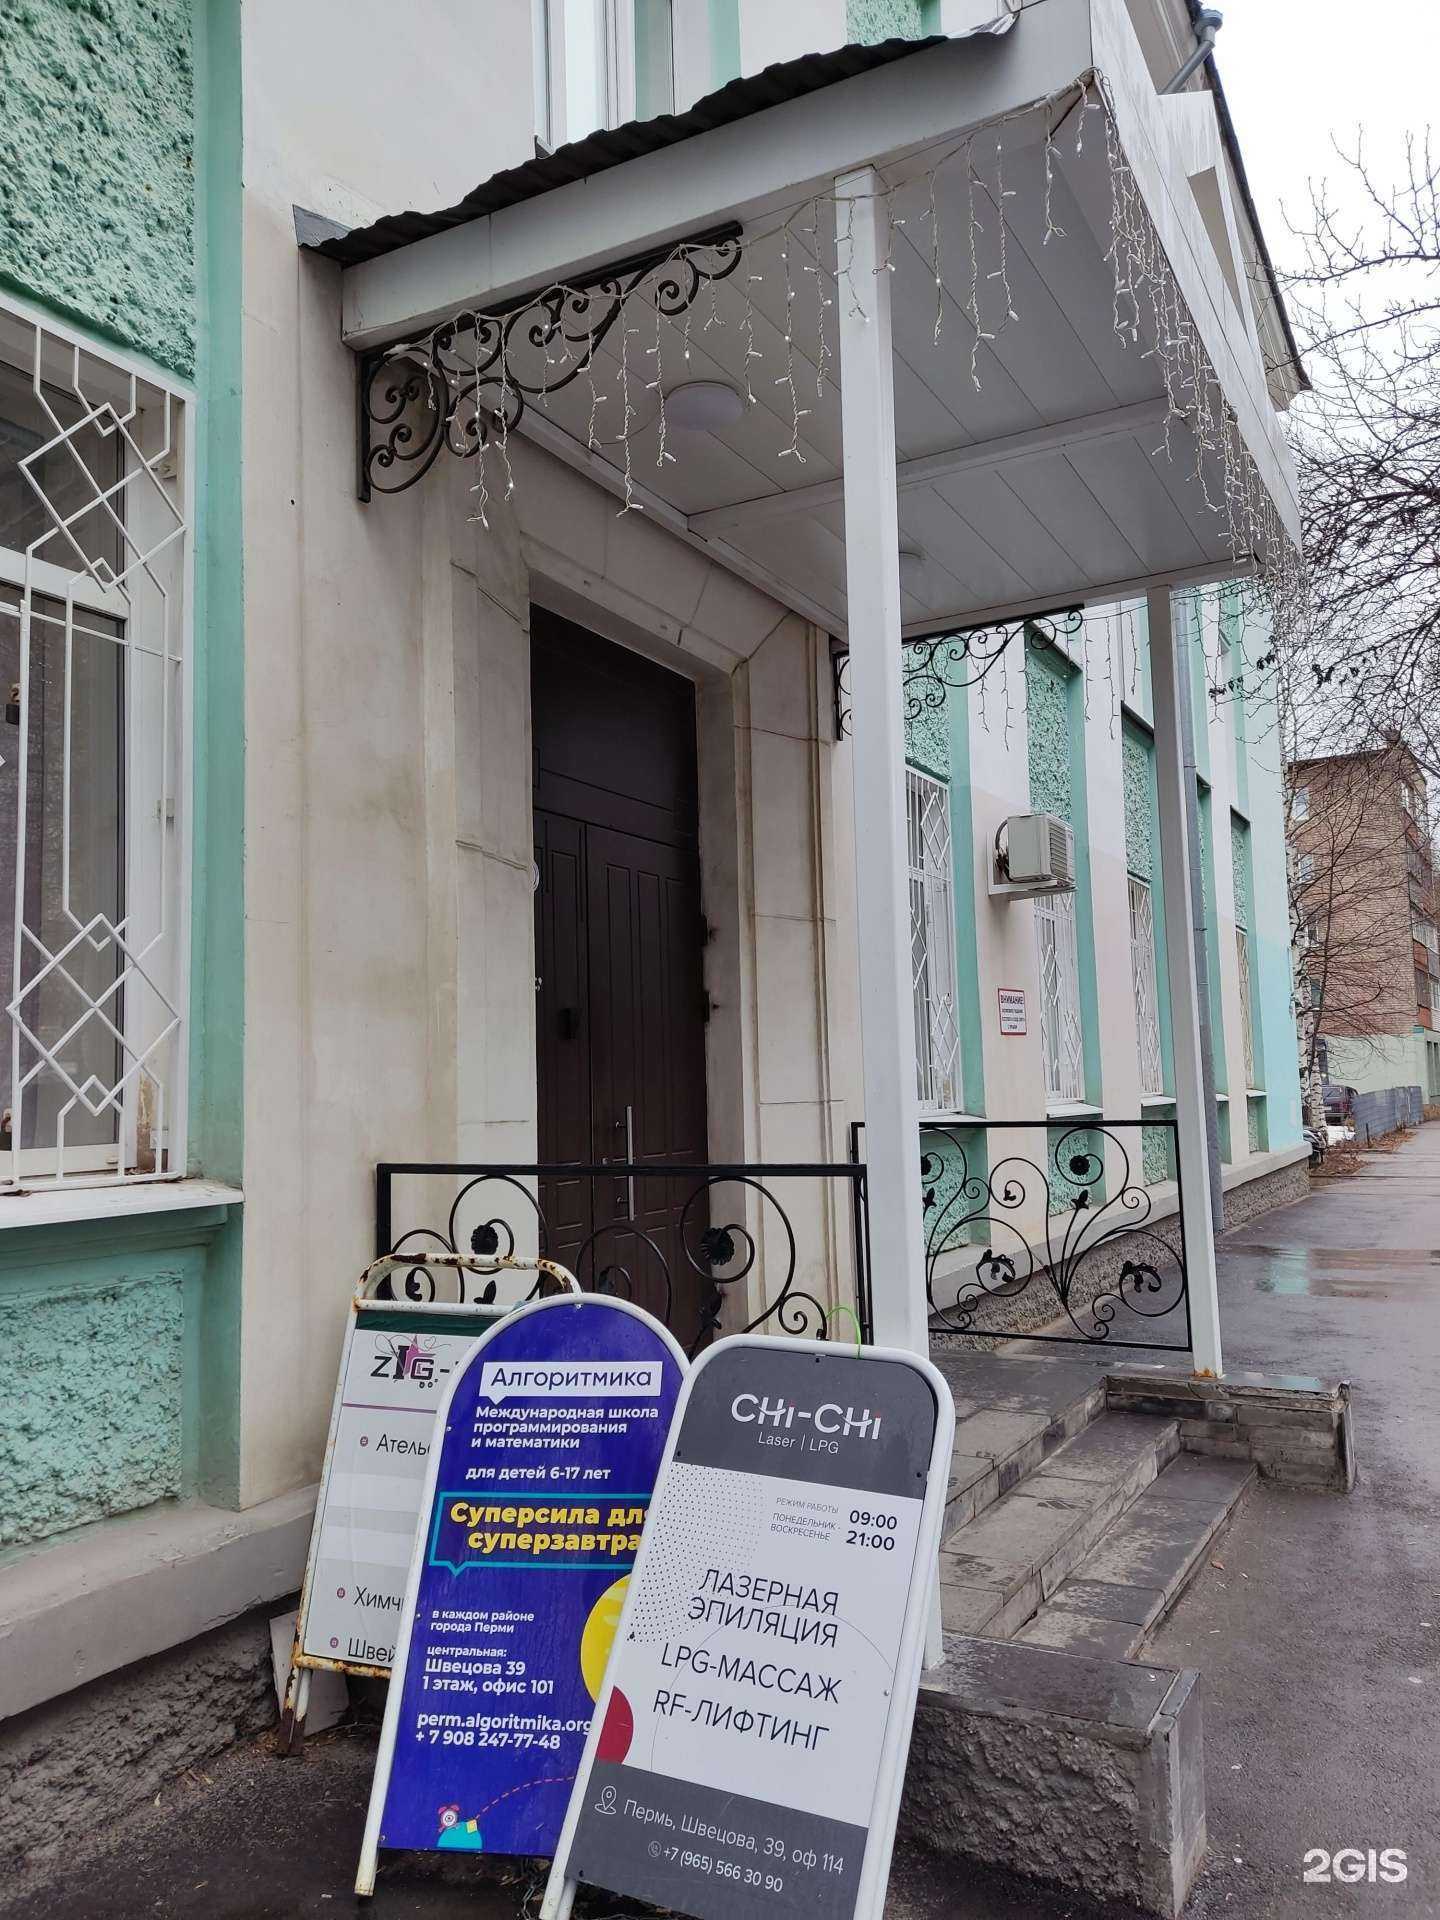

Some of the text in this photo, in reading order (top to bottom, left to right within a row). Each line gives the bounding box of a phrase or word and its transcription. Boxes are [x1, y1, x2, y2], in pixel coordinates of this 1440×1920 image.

[491, 1368, 651, 1390] Алгоритмика
[476, 1407, 659, 1420] Международная школа
[473, 1423, 627, 1435] программирования
[471, 1438, 580, 1449] и математики
[758, 1431, 796, 1448] Laser
[809, 1438, 840, 1454] LPG
[466, 1466, 611, 1480] для детей 6-17 лет
[450, 1503, 600, 1526] Суперсила
[776, 1497, 839, 1513] РЕЖИМ РАБОТЫ
[773, 1512, 836, 1530] ПОНЕДЕЛЬНИК
[849, 1510, 897, 1530] 09:00
[770, 1523, 831, 1541] ВОСКРЕСЕНЬЕ
[846, 1530, 895, 1550] 21:00
[468, 1530, 641, 1556] суперзавтра
[698, 1569, 839, 1616] ЛАЗЕРНАЯ
[432, 1610, 535, 1622] в каждом районе
[688, 1596, 838, 1648] ЭПИЛЯЦИЯ
[430, 1622, 514, 1634] города Перми
[427, 1646, 507, 1657] центральная:
[425, 1658, 526, 1676] Швецова 39
[661, 1642, 842, 1704] LPG-МАССАЖ
[422, 1676, 554, 1695] 1 этаж, офис 101
[417, 1713, 592, 1735] perm.algoritmika.org
[653, 1690, 830, 1750] RF-ЛИФТИНГ
[429, 1730, 439, 1744] 7
[443, 1731, 474, 1745] 908
[478, 1732, 561, 1749] 247-77-48
[623, 1799, 844, 1875] Пермь, Швецова, 39, оф 114
[663, 1847, 783, 1893] +7 (965) 566 30 90
